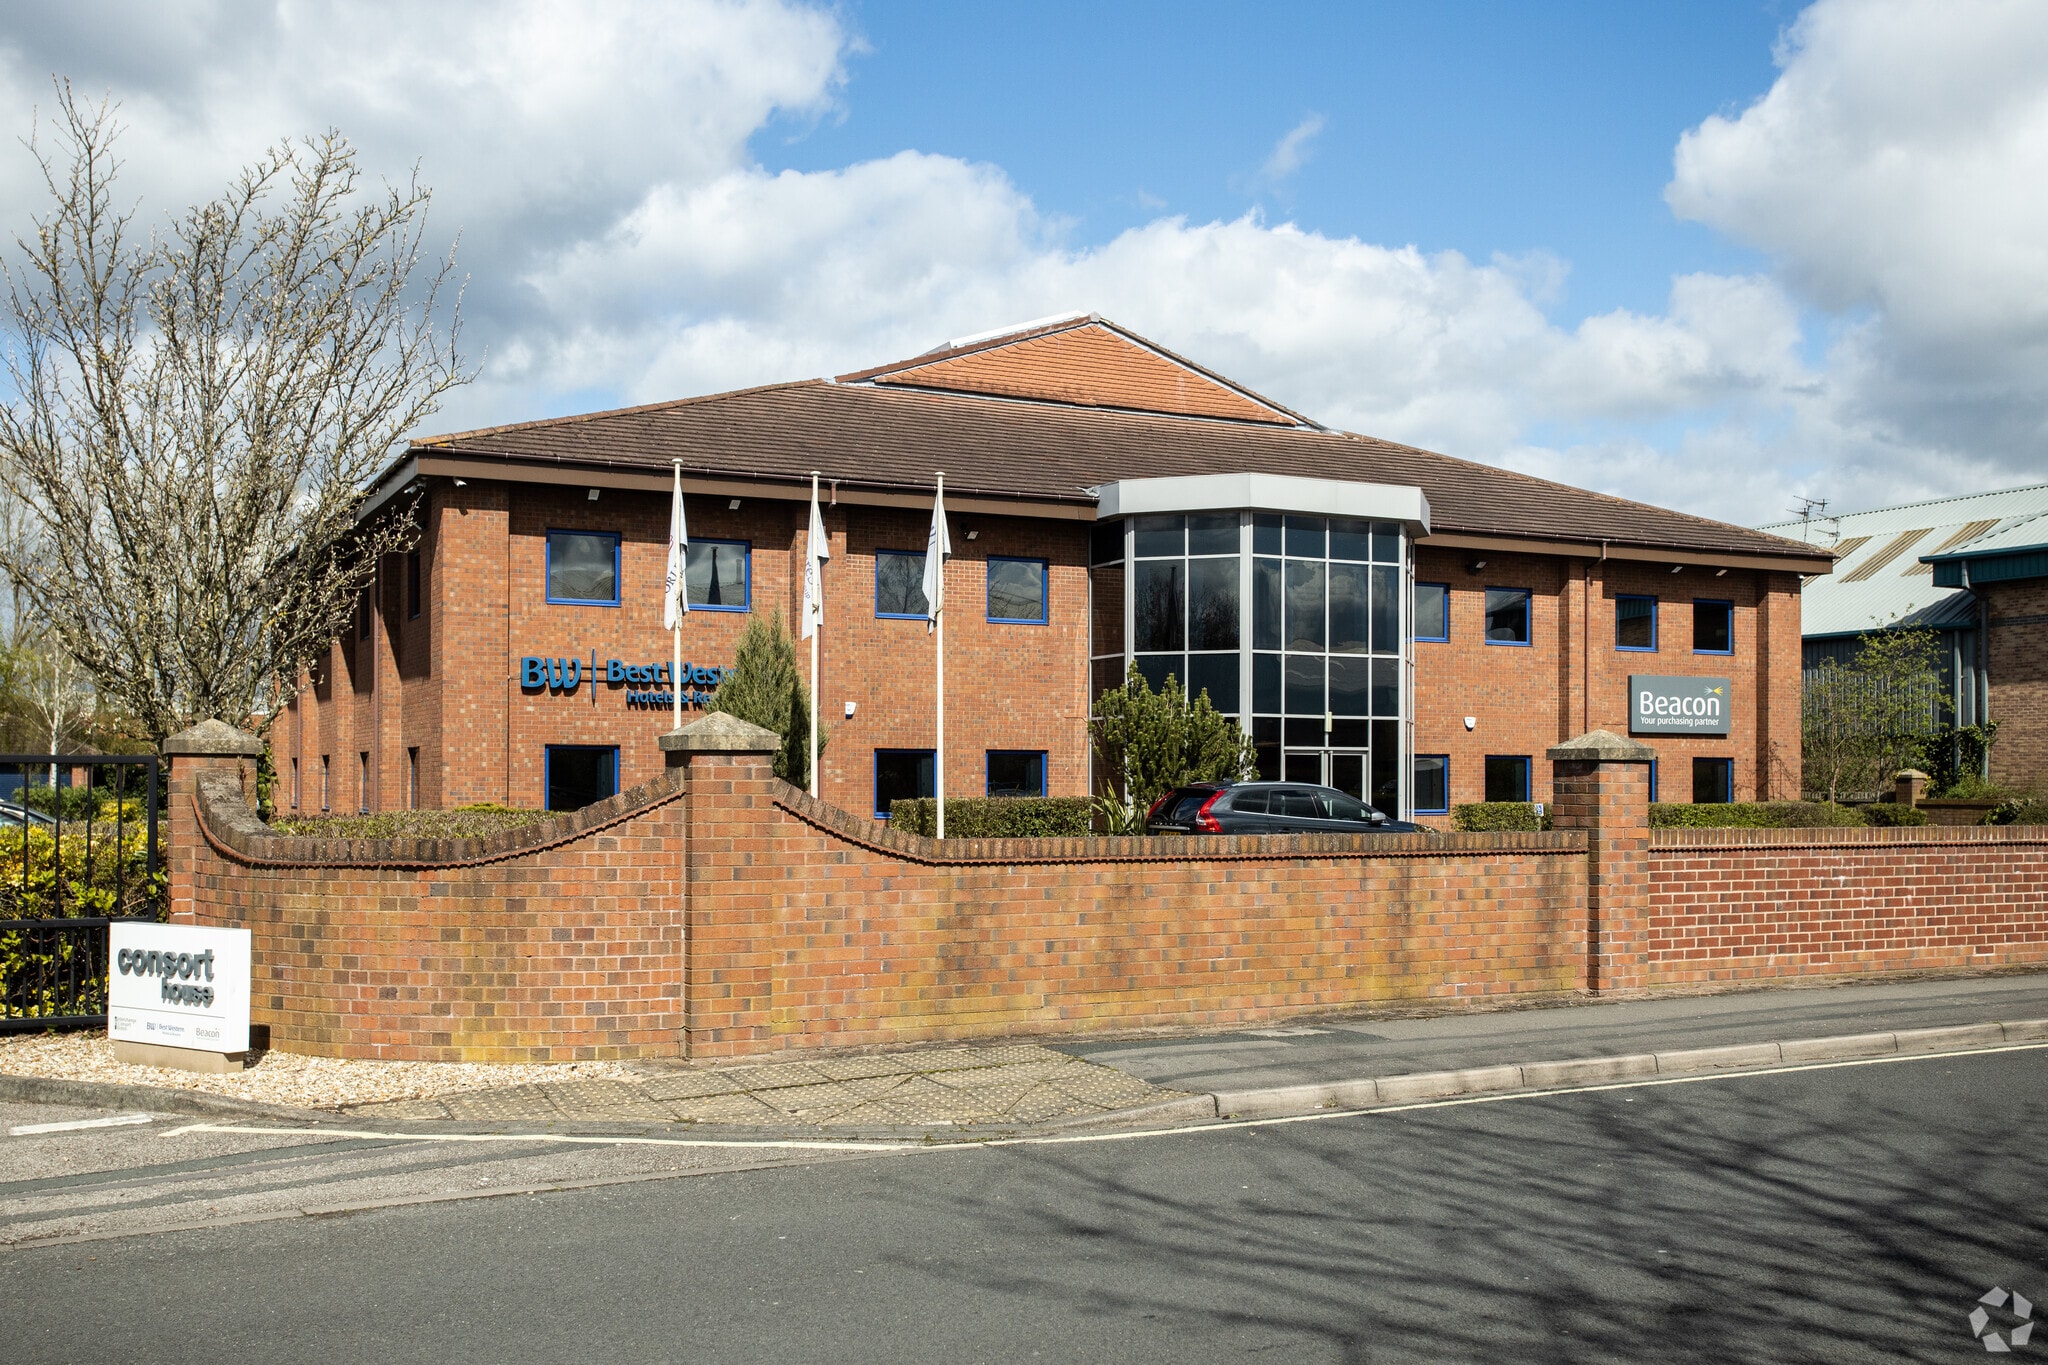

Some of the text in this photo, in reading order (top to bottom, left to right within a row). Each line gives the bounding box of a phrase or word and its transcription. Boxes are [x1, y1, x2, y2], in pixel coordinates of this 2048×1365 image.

[521, 656, 581, 690] BW
[607, 659, 740, 685] Best West
[627, 689, 675, 704] Hotels
[1639, 691, 1720, 716] Beacon
[1640, 716, 1719, 727] Your purchasing partner
[117, 948, 215, 982] consort
[161, 976, 215, 1008] house
[195, 1027, 220, 1039] Beacon
